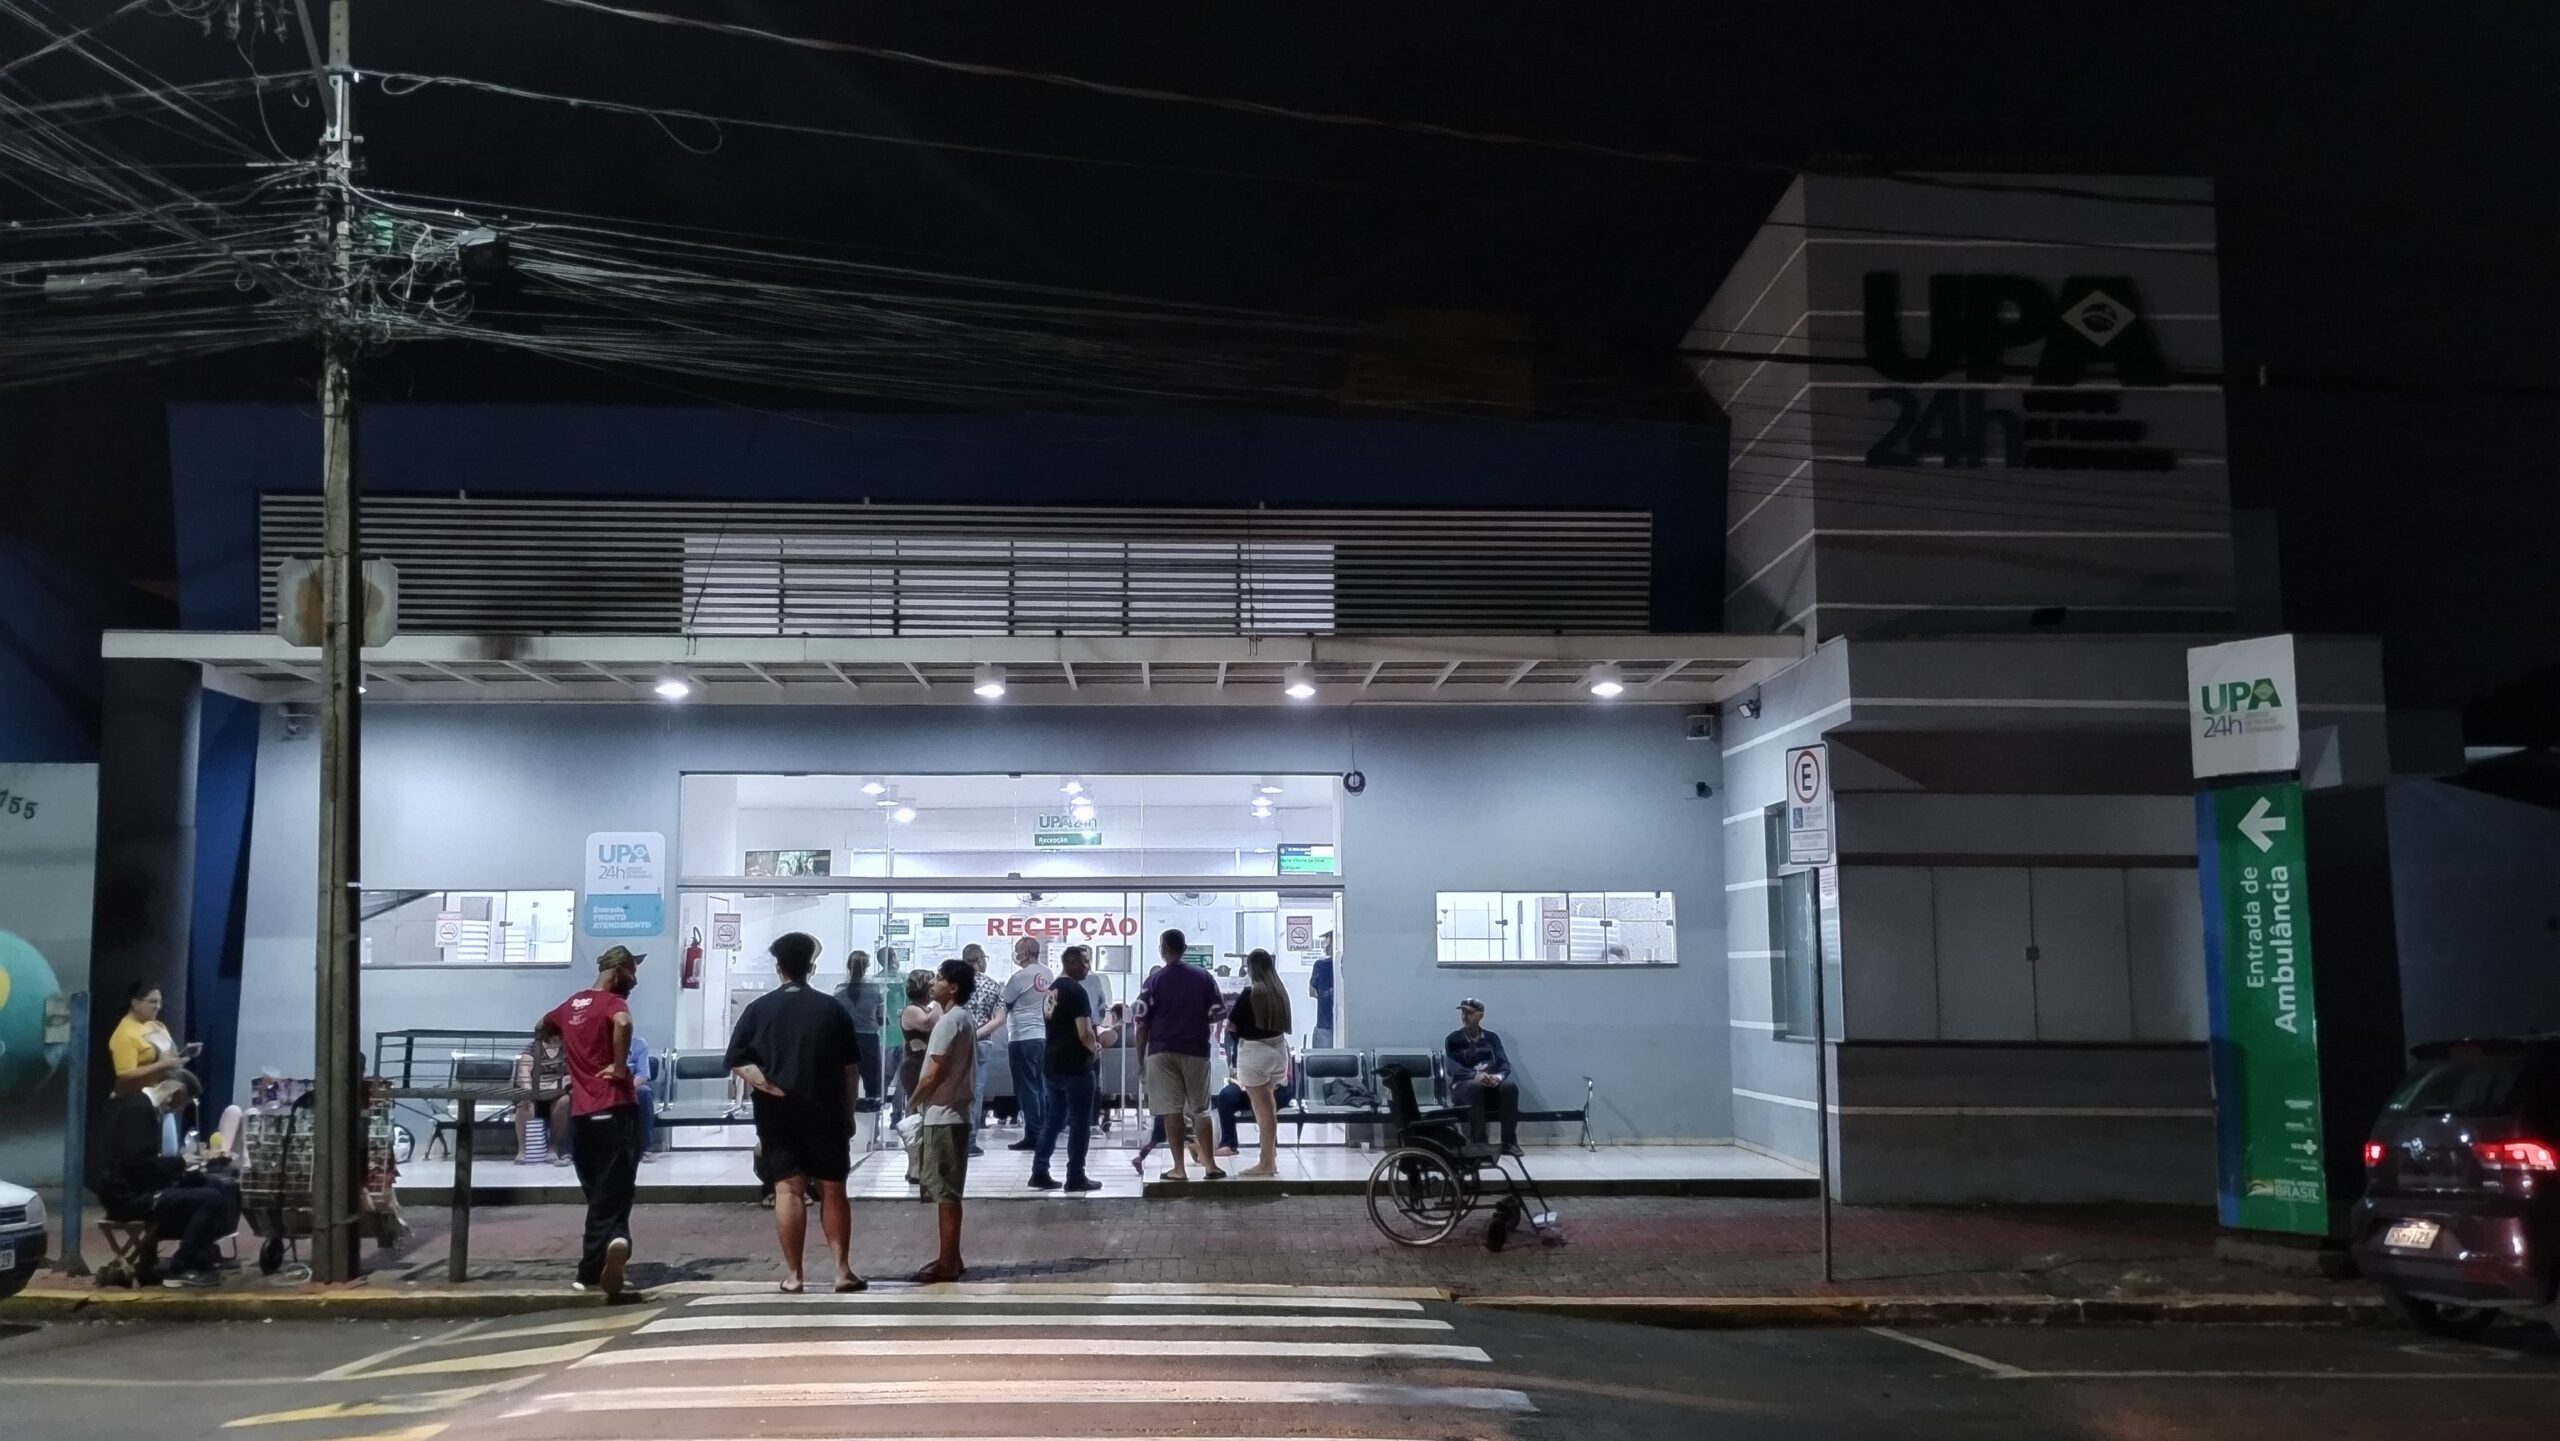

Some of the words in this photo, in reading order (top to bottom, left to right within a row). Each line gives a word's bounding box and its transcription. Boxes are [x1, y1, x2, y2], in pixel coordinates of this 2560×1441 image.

[1864, 270, 2163, 386] UPA
[1865, 387, 2023, 467] 24h
[2202, 678, 2282, 715] UPA
[2203, 715, 2242, 738] 24h
[1801, 763, 1812, 791] E
[1039, 816, 1072, 828] UPA
[598, 844, 651, 863] UPA
[599, 866, 625, 880] 24h
[2240, 867, 2259, 894] de
[987, 913, 1138, 942] RECEPÇÃO
[2243, 901, 2265, 988] Entrada
[2266, 866, 2297, 1034] Ambulância
[2275, 1185, 2319, 1199] BRASIL
